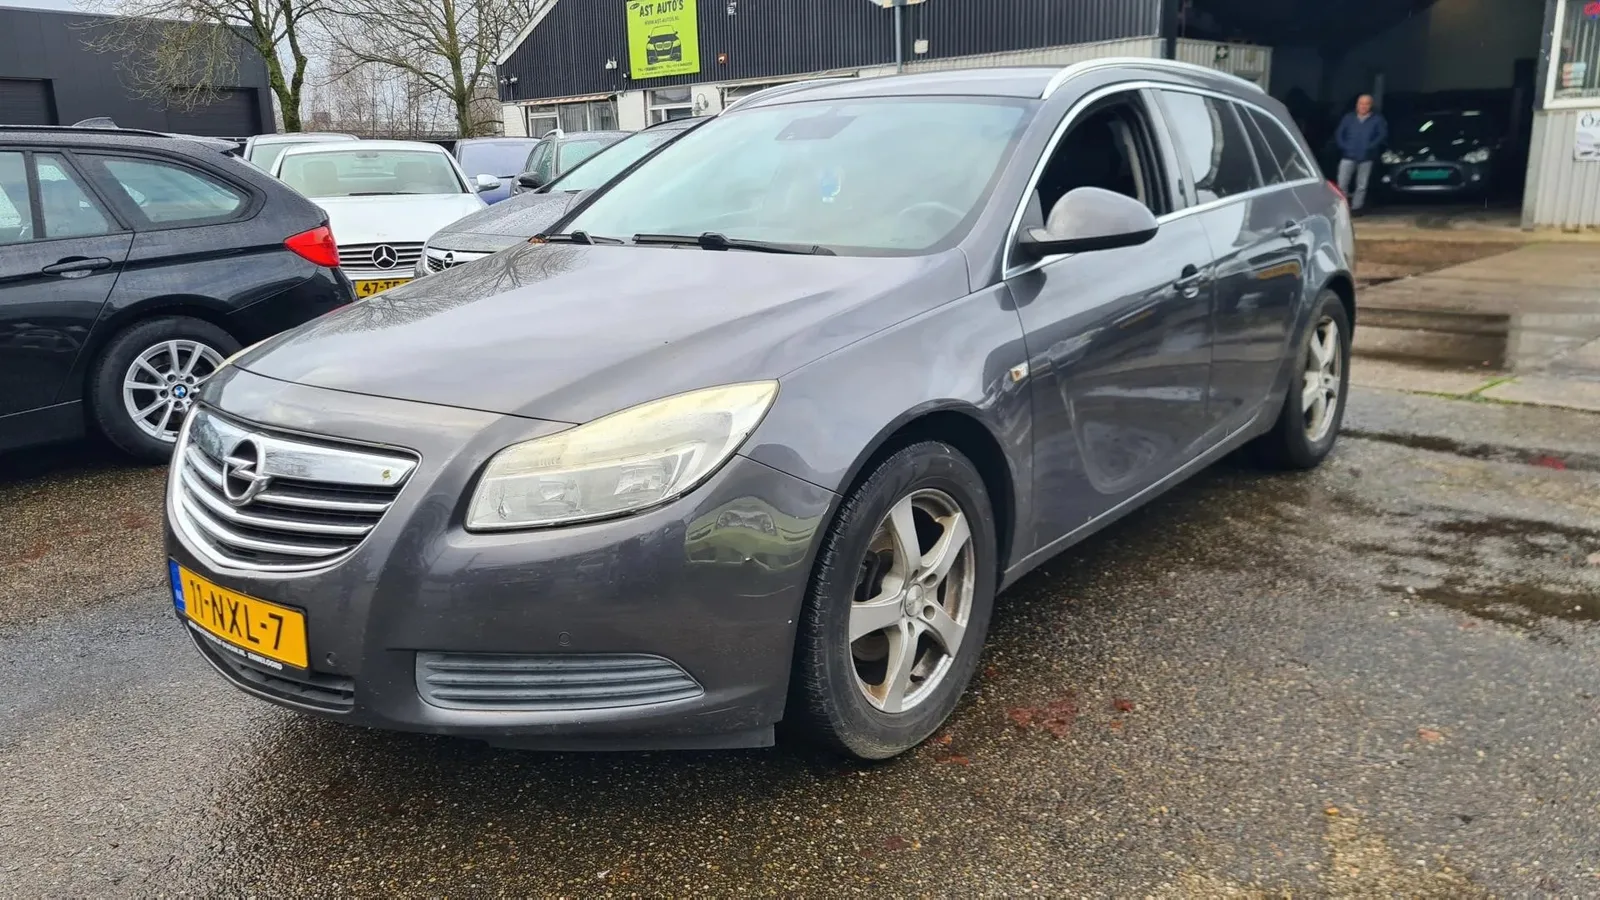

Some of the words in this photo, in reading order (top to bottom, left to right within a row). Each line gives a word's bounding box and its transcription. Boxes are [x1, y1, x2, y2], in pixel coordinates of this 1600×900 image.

[640, 4, 653, 17] AST
[657, 0, 684, 14] AUTO'S
[190, 579, 284, 650] 11-NXL-7
